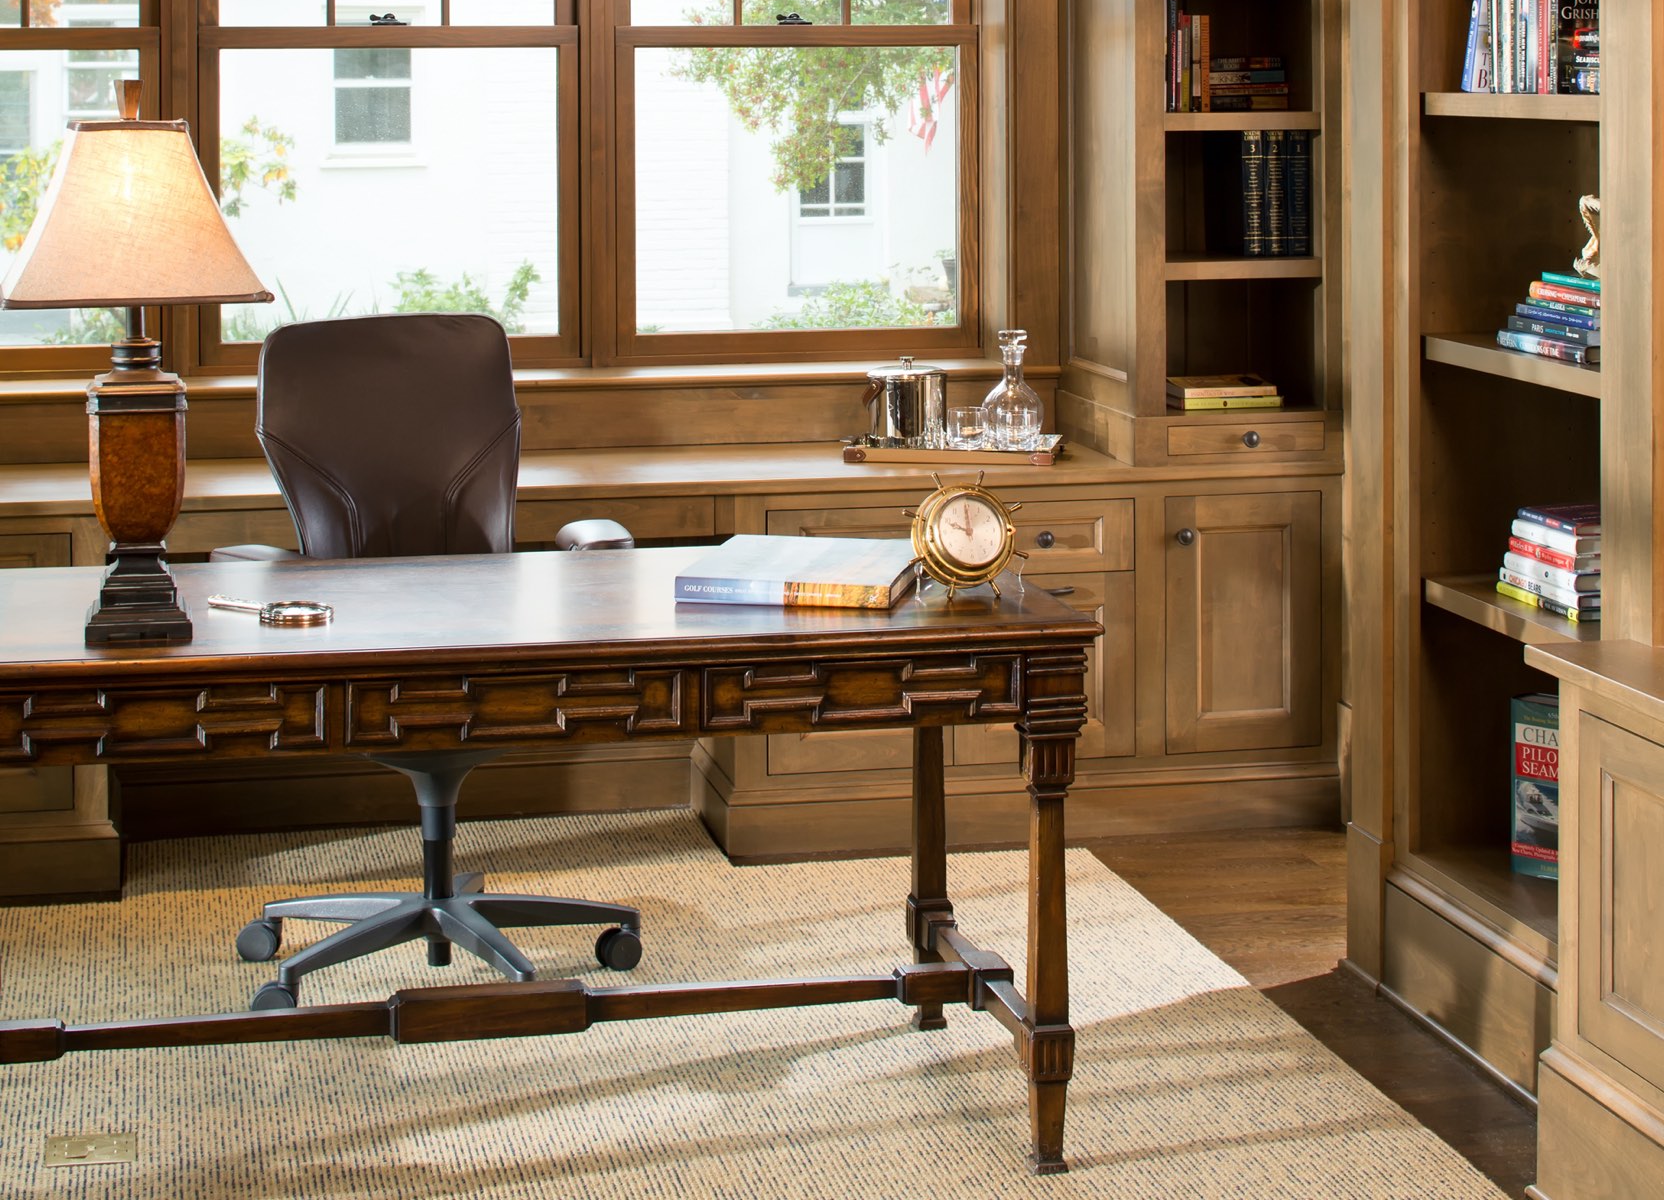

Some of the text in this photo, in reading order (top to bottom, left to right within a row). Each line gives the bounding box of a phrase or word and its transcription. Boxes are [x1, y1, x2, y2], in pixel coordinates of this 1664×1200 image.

[1250, 144, 1255, 153] 3
[1272, 144, 1278, 153] 2
[1296, 144, 1301, 152] 1
[1532, 323, 1543, 333] PARIS
[1528, 581, 1541, 593] BEARS
